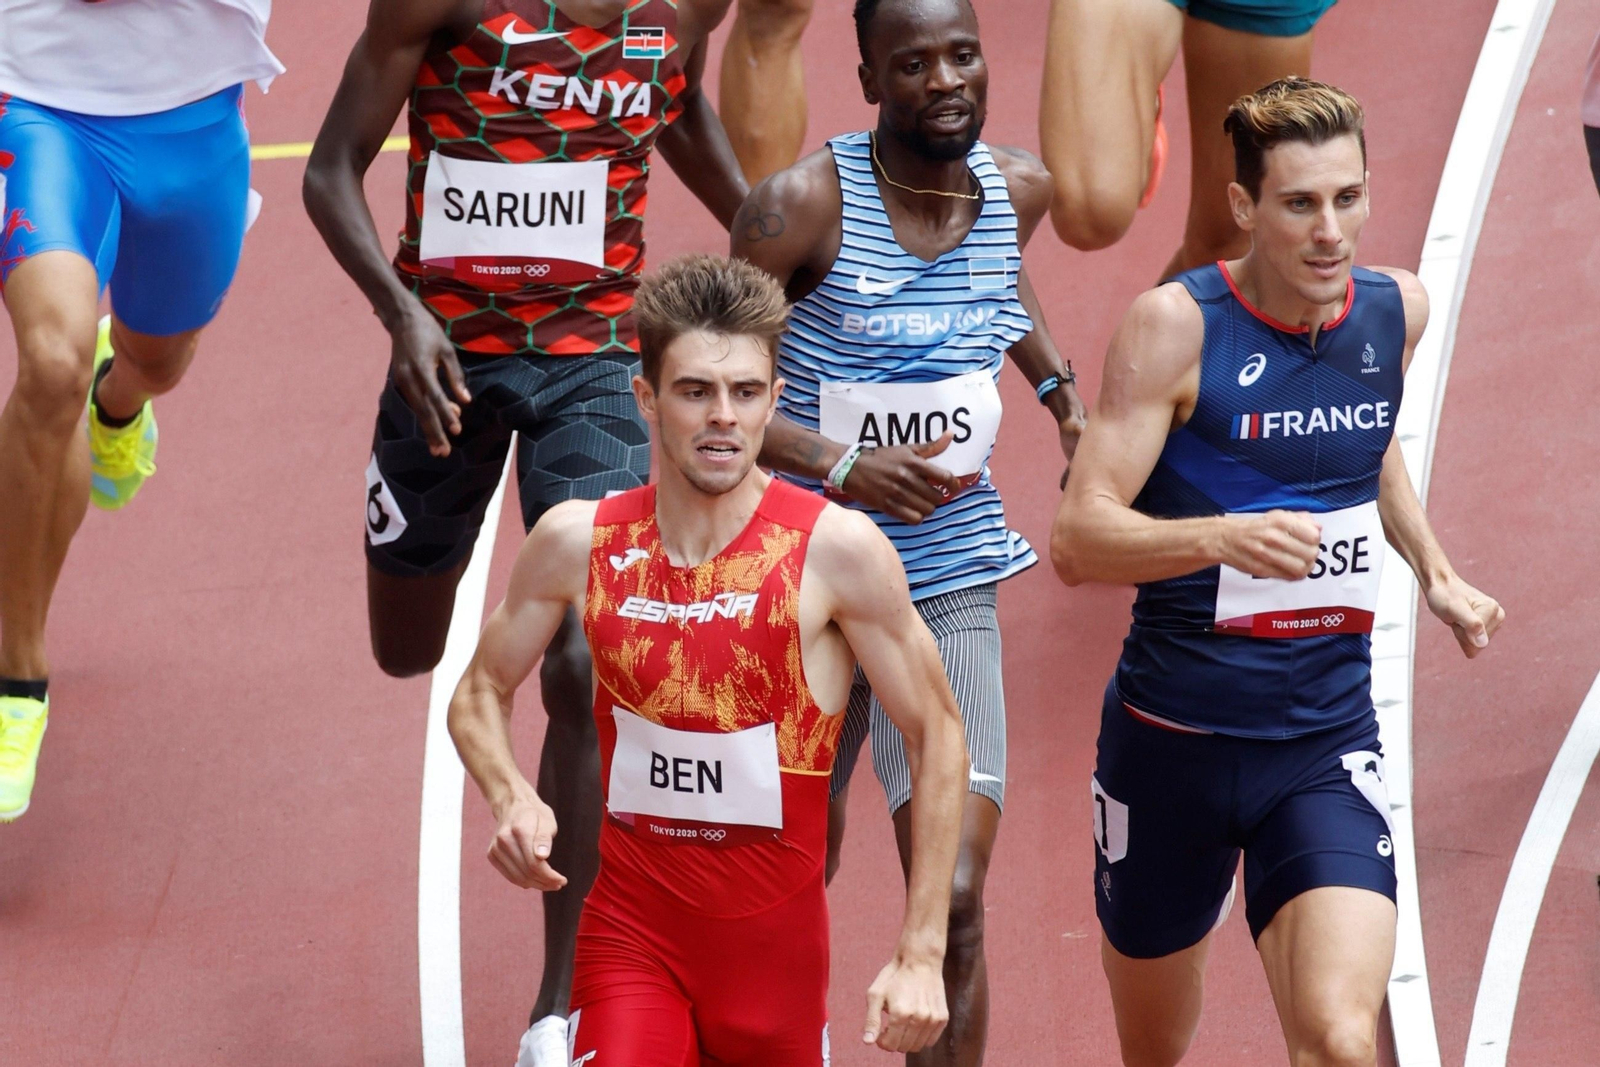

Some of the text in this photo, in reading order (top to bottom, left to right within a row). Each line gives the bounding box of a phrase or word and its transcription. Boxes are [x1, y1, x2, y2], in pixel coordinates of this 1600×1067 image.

[488, 66, 650, 118] KENYA
[443, 186, 585, 228] SARUNI
[471, 263, 522, 275] TOKYO 2020
[1361, 366, 1380, 374] FRANCE
[858, 406, 972, 448] AMOS
[1263, 401, 1390, 439] FRANCE
[367, 481, 390, 534] 6
[1252, 535, 1370, 579] SSE
[617, 591, 760, 625] ESPAÑA
[1271, 618, 1320, 629] TOKYO 2020
[649, 751, 723, 794] BEN
[649, 824, 698, 838] TOKYO 2020
